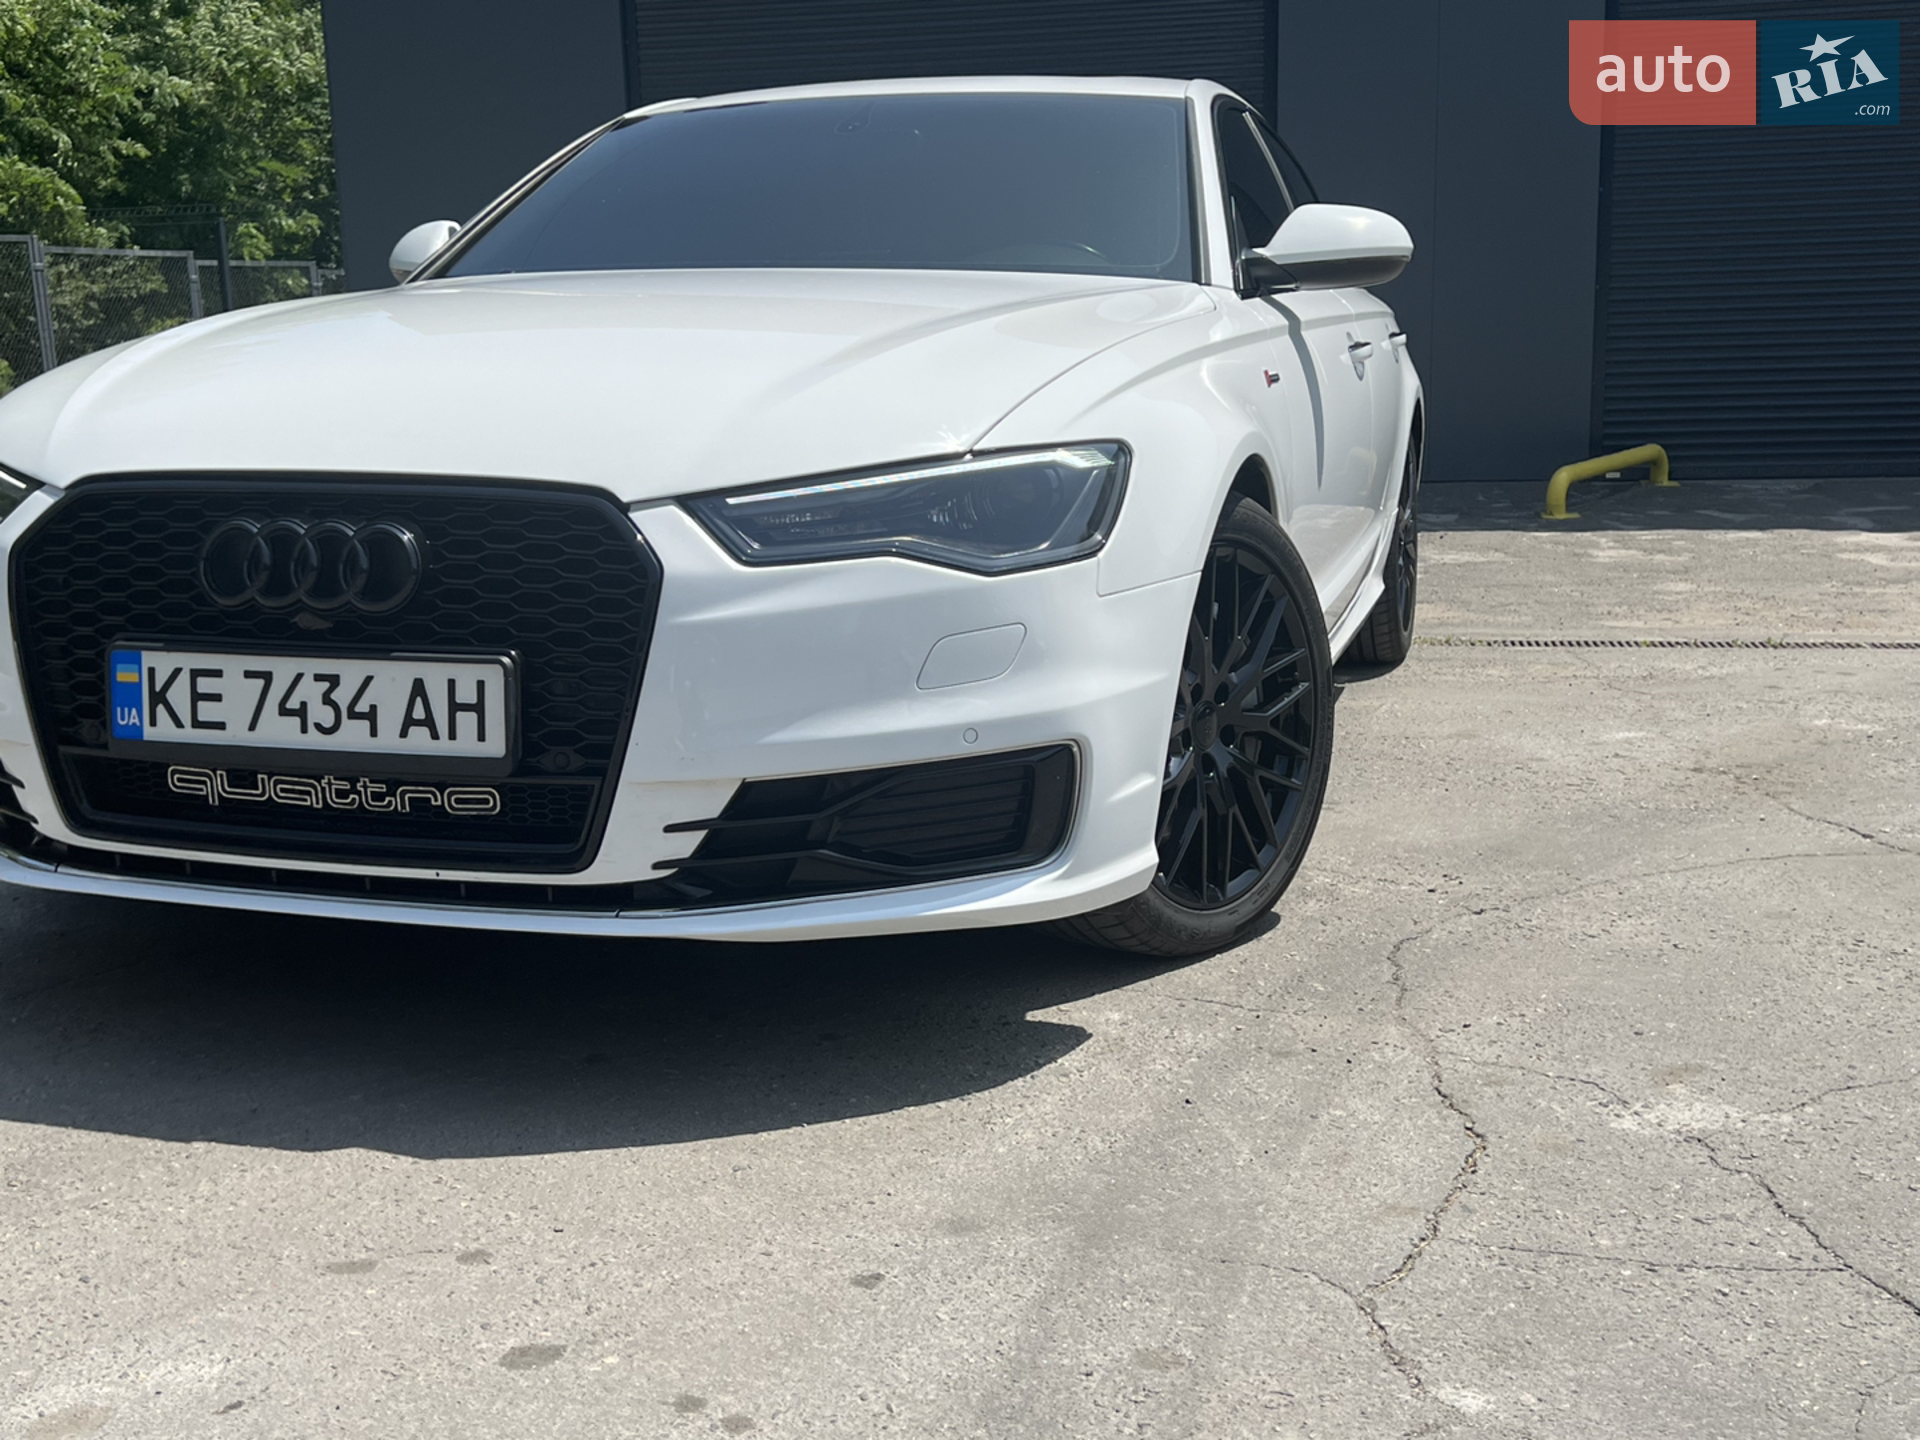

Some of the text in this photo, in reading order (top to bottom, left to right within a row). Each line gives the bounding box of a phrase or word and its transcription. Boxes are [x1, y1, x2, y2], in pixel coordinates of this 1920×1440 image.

[116, 706, 140, 726] UA
[147, 666, 486, 743] KE 7434 AH
[167, 765, 500, 815] quattro
